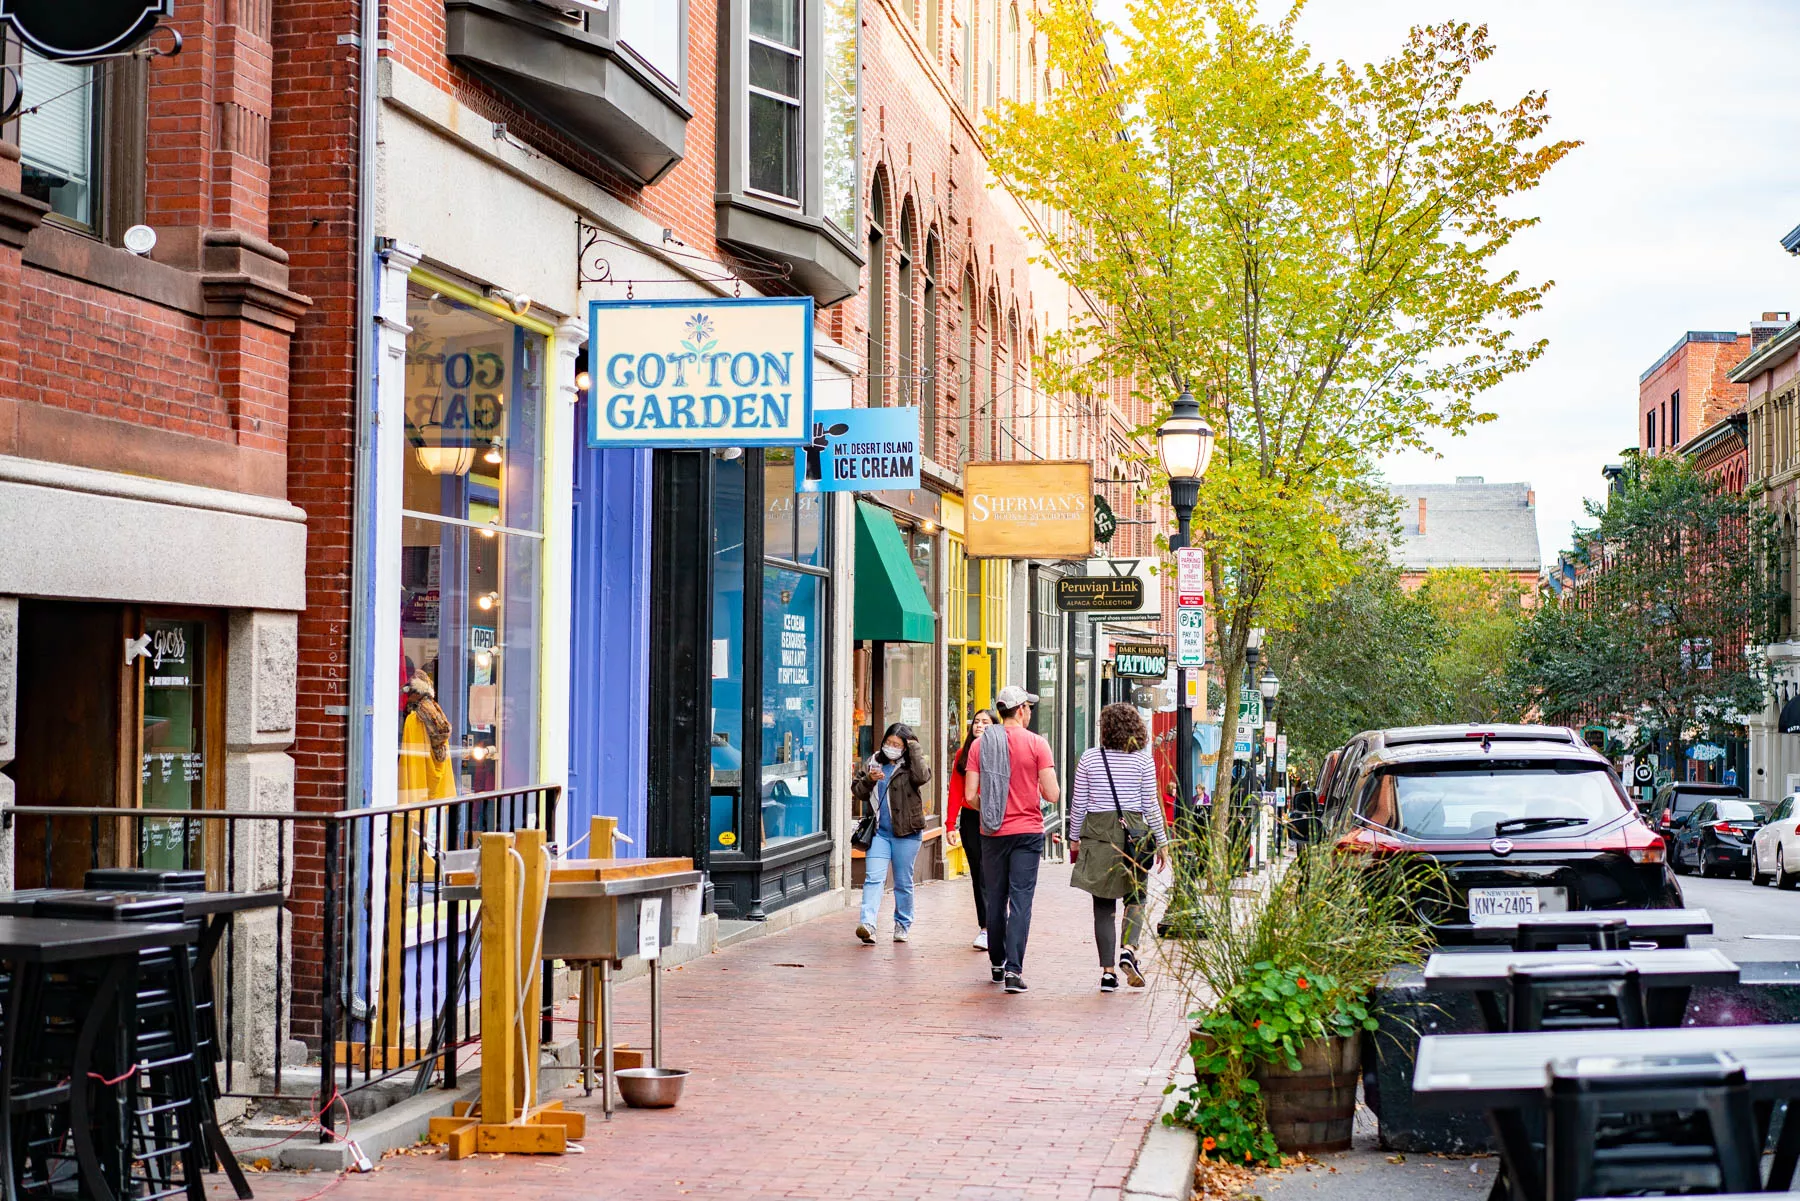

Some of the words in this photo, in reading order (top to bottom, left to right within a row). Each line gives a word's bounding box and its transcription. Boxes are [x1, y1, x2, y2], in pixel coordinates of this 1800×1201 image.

[606, 352, 794, 389] COTTON
[606, 393, 792, 431] GARDEN
[834, 443, 849, 455] MT.
[851, 442, 880, 455] DESERT
[884, 441, 913, 454] ISLAND
[834, 457, 857, 479] ICE
[861, 456, 914, 478] CREAM
[972, 493, 1085, 522] SHERMAN'S
[1061, 581, 1109, 593] Peruvian
[1112, 581, 1139, 592] Link
[154, 627, 187, 670] gross
[474, 629, 495, 648] OPEN
[1116, 654, 1166, 674] TATTOOS
